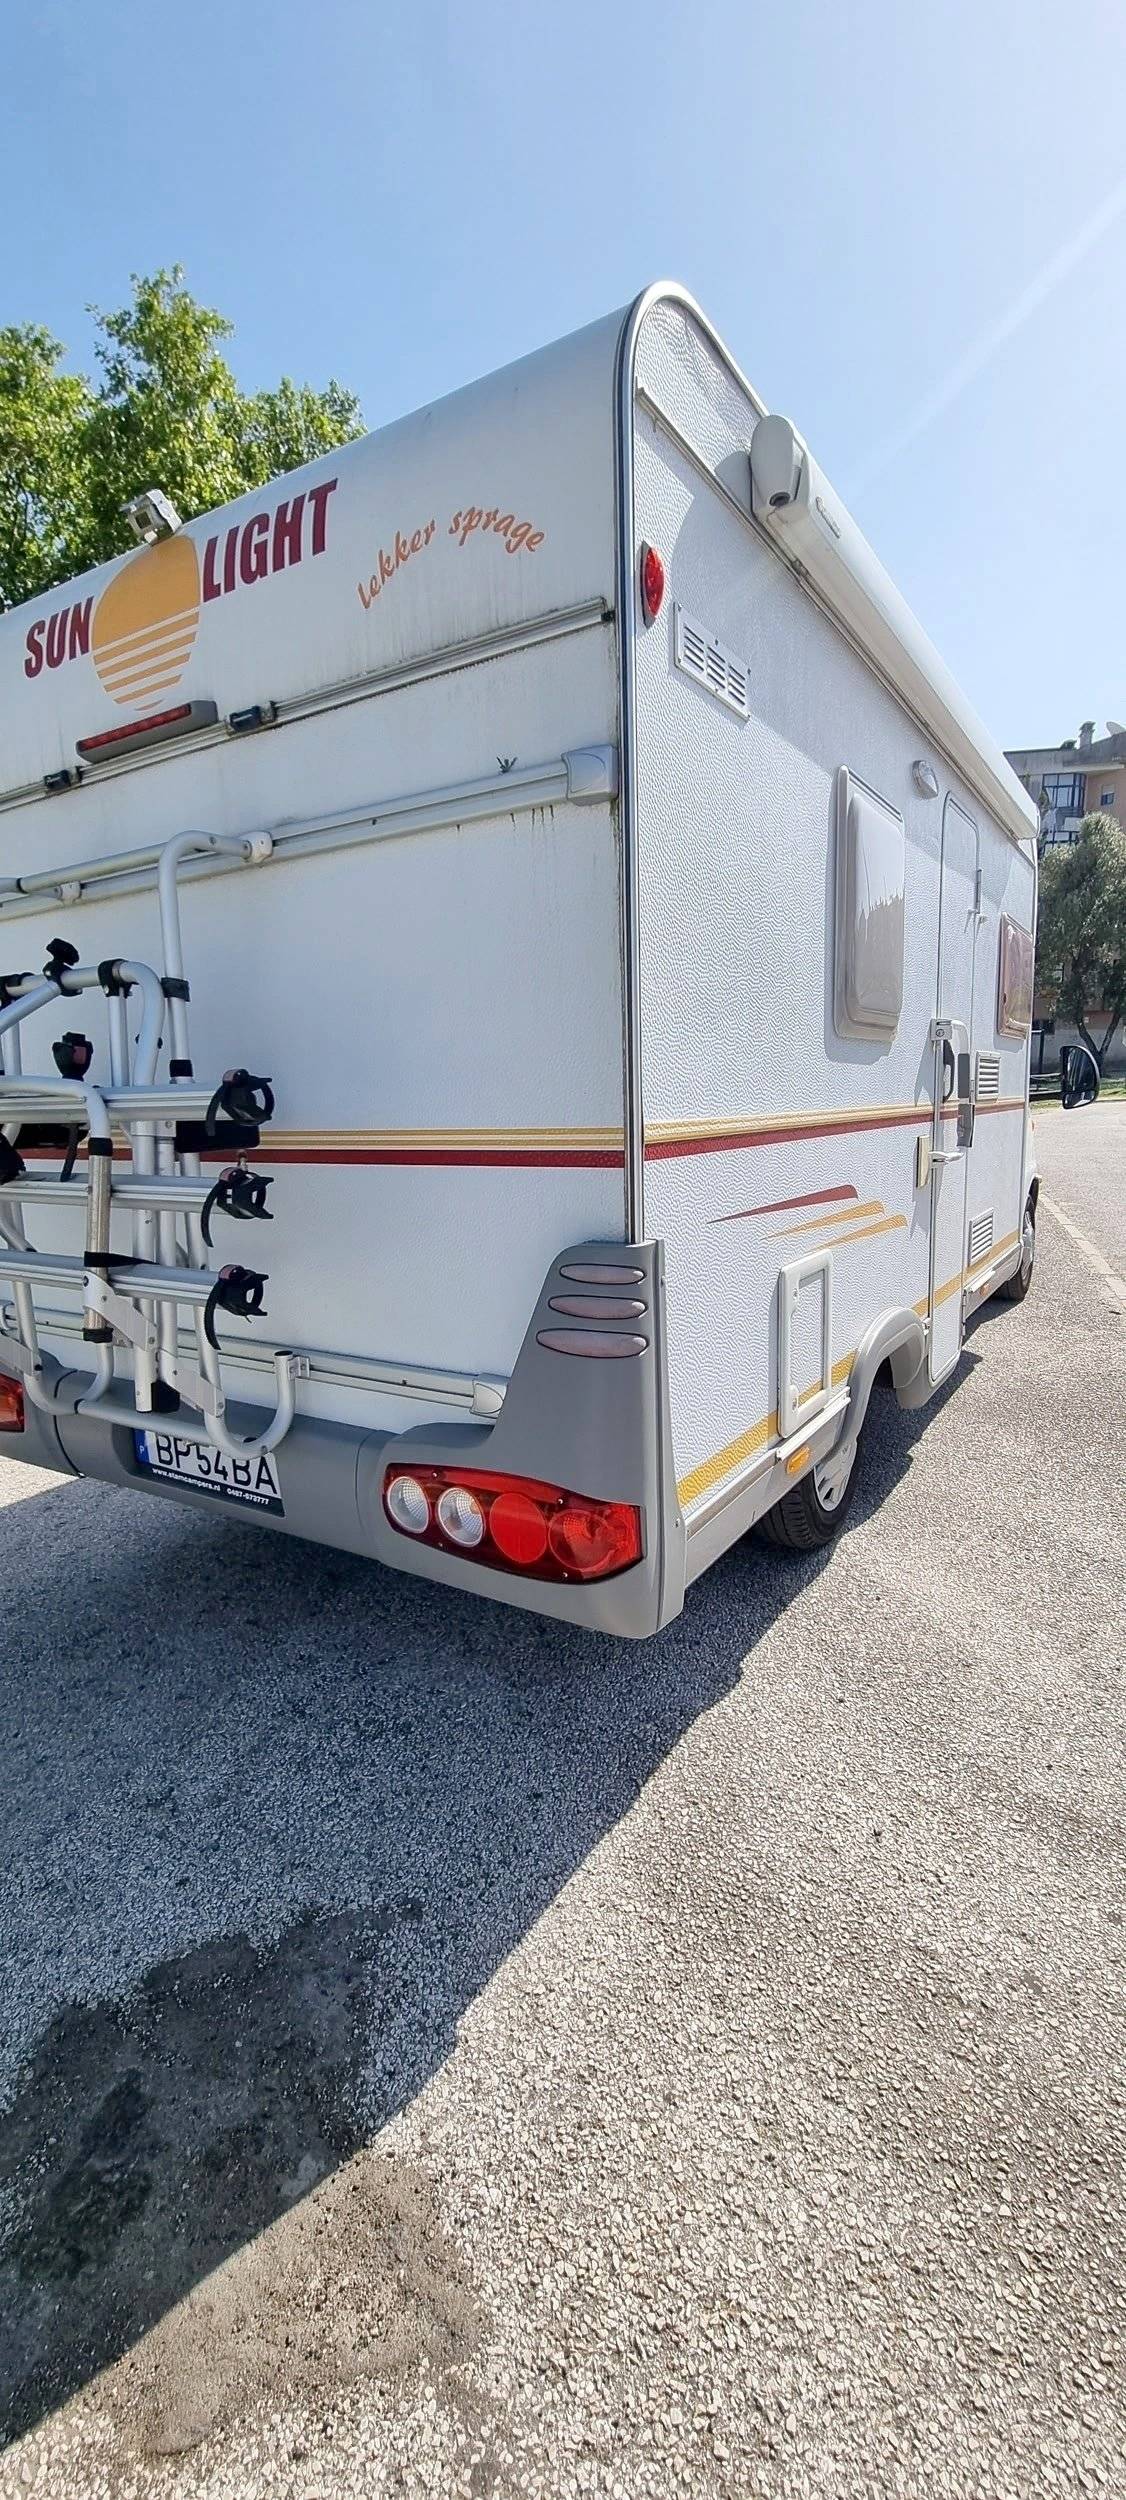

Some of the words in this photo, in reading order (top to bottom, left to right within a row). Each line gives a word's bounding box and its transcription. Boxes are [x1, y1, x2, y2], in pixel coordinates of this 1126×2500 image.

[24, 596, 94, 679] SUN
[203, 478, 338, 602] LIGHT
[448, 506, 545, 553] sprage
